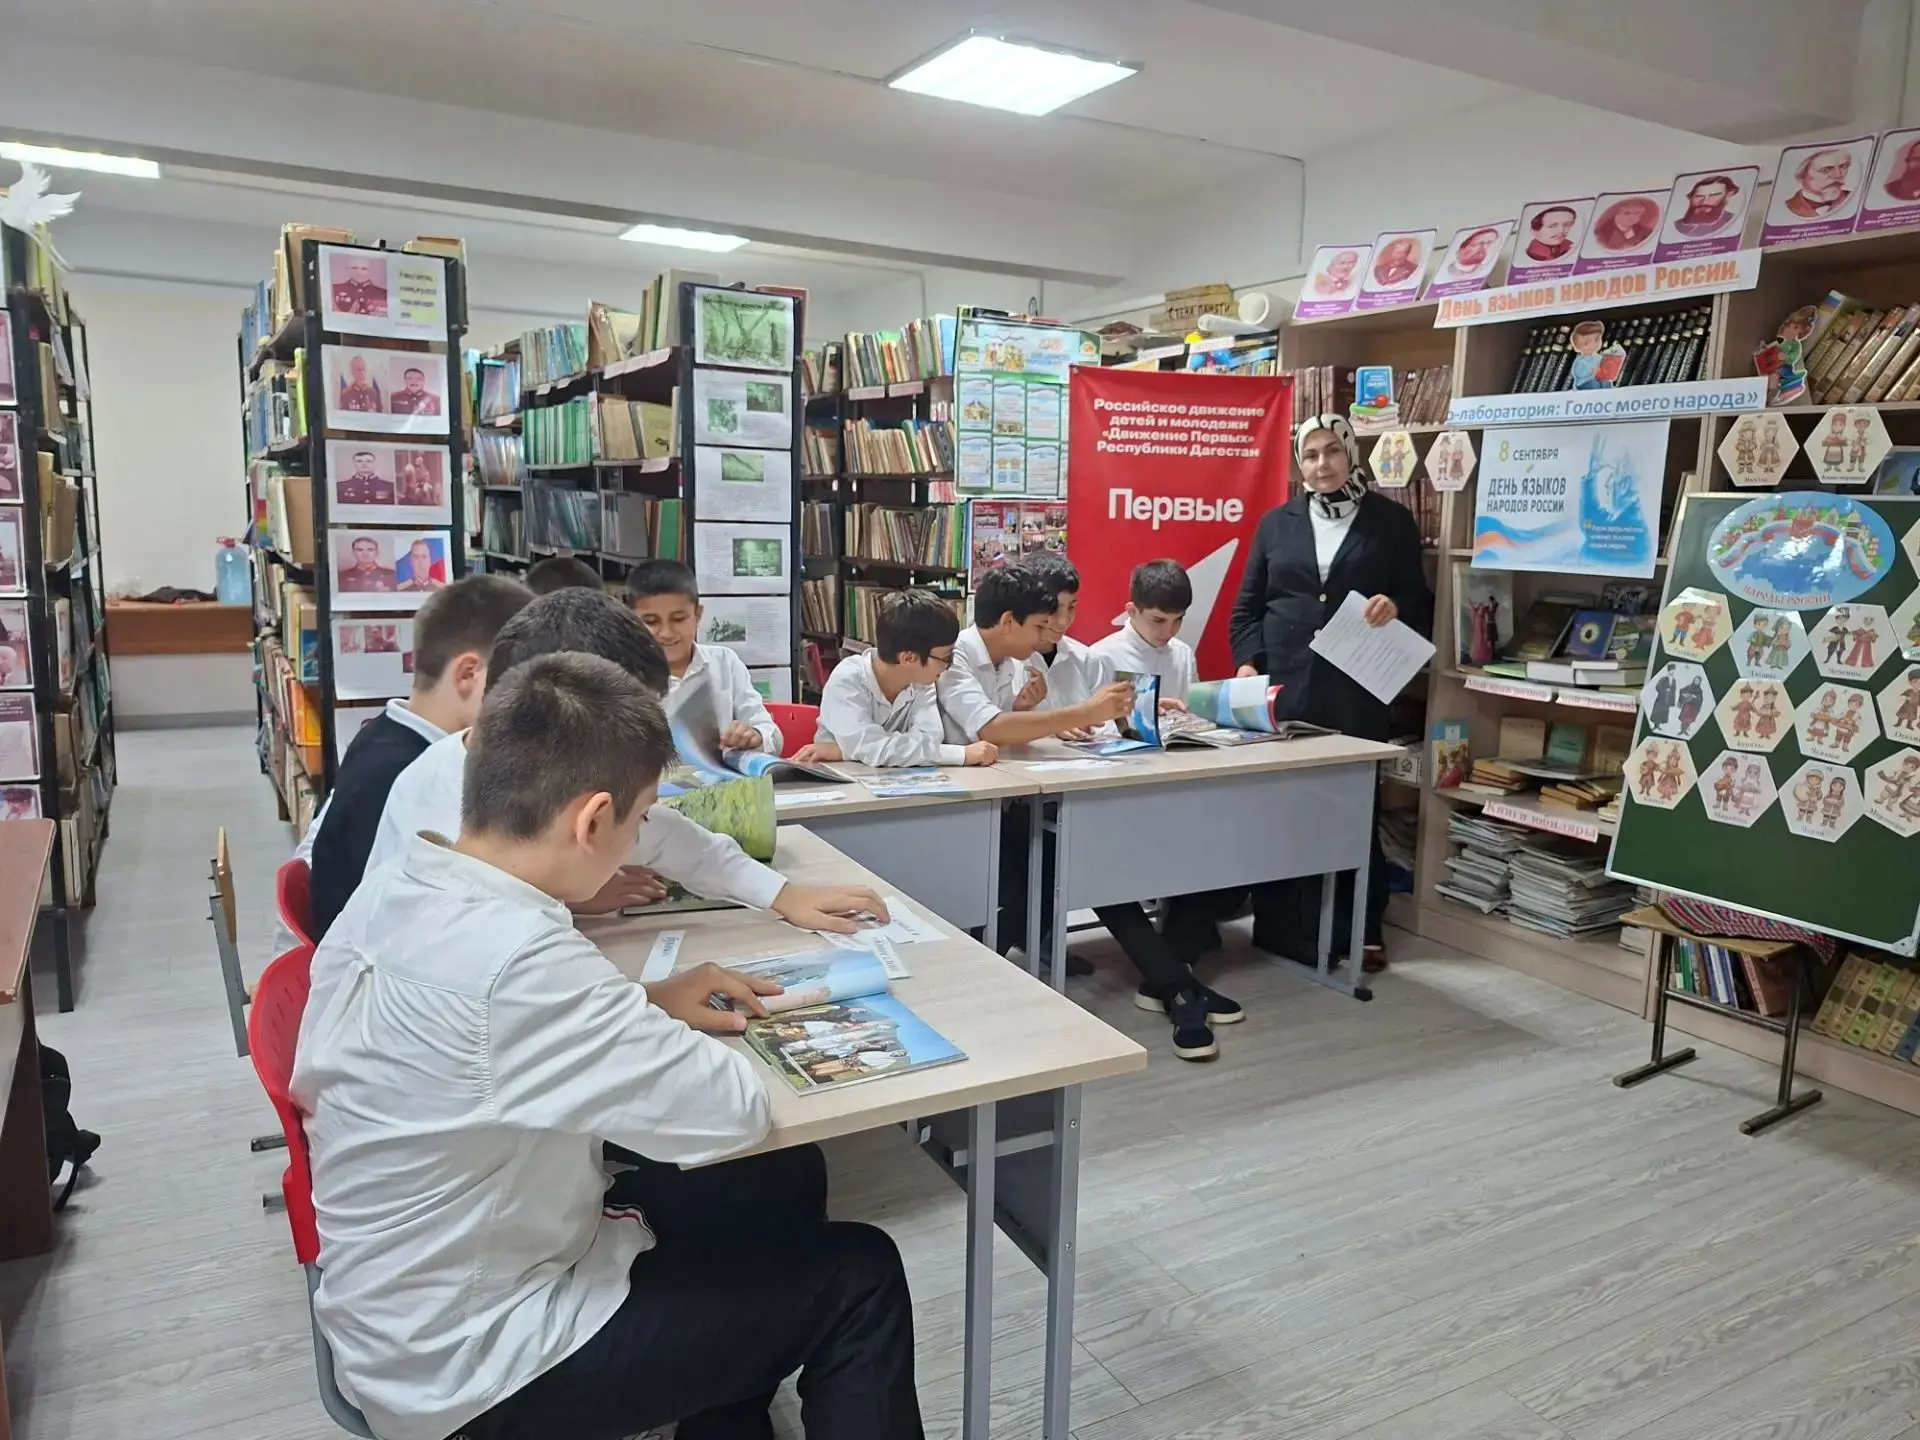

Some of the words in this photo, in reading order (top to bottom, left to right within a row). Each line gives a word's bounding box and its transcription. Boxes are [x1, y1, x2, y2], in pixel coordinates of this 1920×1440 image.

[1442, 298, 1482, 321] День
[1488, 287, 1555, 313] языков
[1561, 273, 1646, 303] народов
[1655, 260, 1741, 290] России.
[1094, 398, 1187, 415] Российское
[1189, 402, 1265, 417] движение
[1565, 400, 1611, 415] Голос
[1616, 397, 1670, 413] моего
[1674, 392, 1759, 410] народа»
[1109, 415, 1156, 427] детей
[1158, 418, 1168, 427] и
[1170, 418, 1249, 430] молодежи
[1102, 427, 1188, 442] «Движение
[1191, 428, 1254, 444] Первых»
[1097, 441, 1188, 456] Республики
[1189, 444, 1260, 458] Дагестан
[1499, 440, 1510, 461] 8
[1512, 448, 1559, 461] СЕНТЯБРЯ
[1488, 478, 1517, 497] ДЕНЬ
[1521, 477, 1566, 496] ЯЗЫКОВ
[1109, 488, 1244, 530] Первые
[1487, 500, 1528, 513] НАРОДОВ
[1530, 499, 1565, 513] РОССИИ
